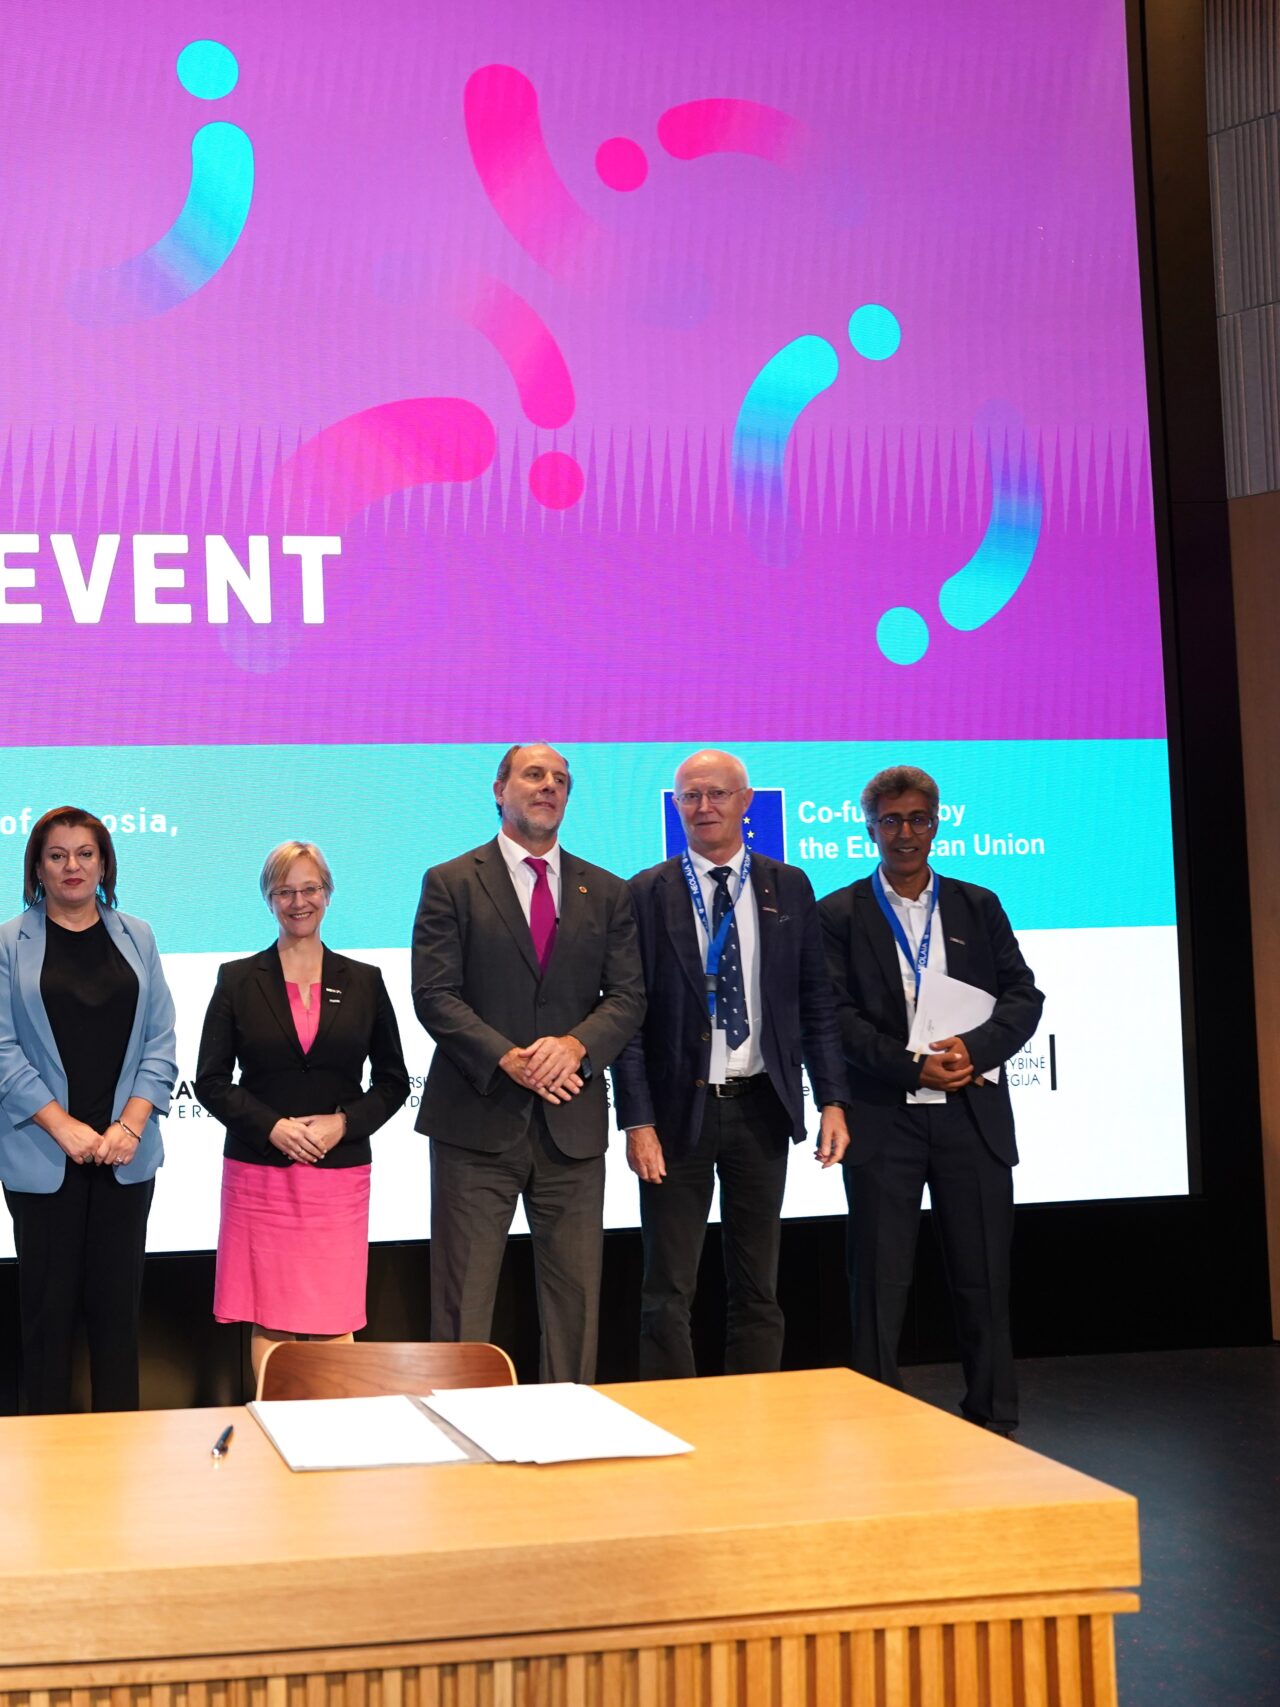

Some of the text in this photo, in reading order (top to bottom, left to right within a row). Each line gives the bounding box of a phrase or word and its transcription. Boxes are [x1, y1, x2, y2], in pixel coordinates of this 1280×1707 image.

[0, 807, 32, 835] of
[798, 836, 839, 859] the
[973, 832, 1045, 856] Union
